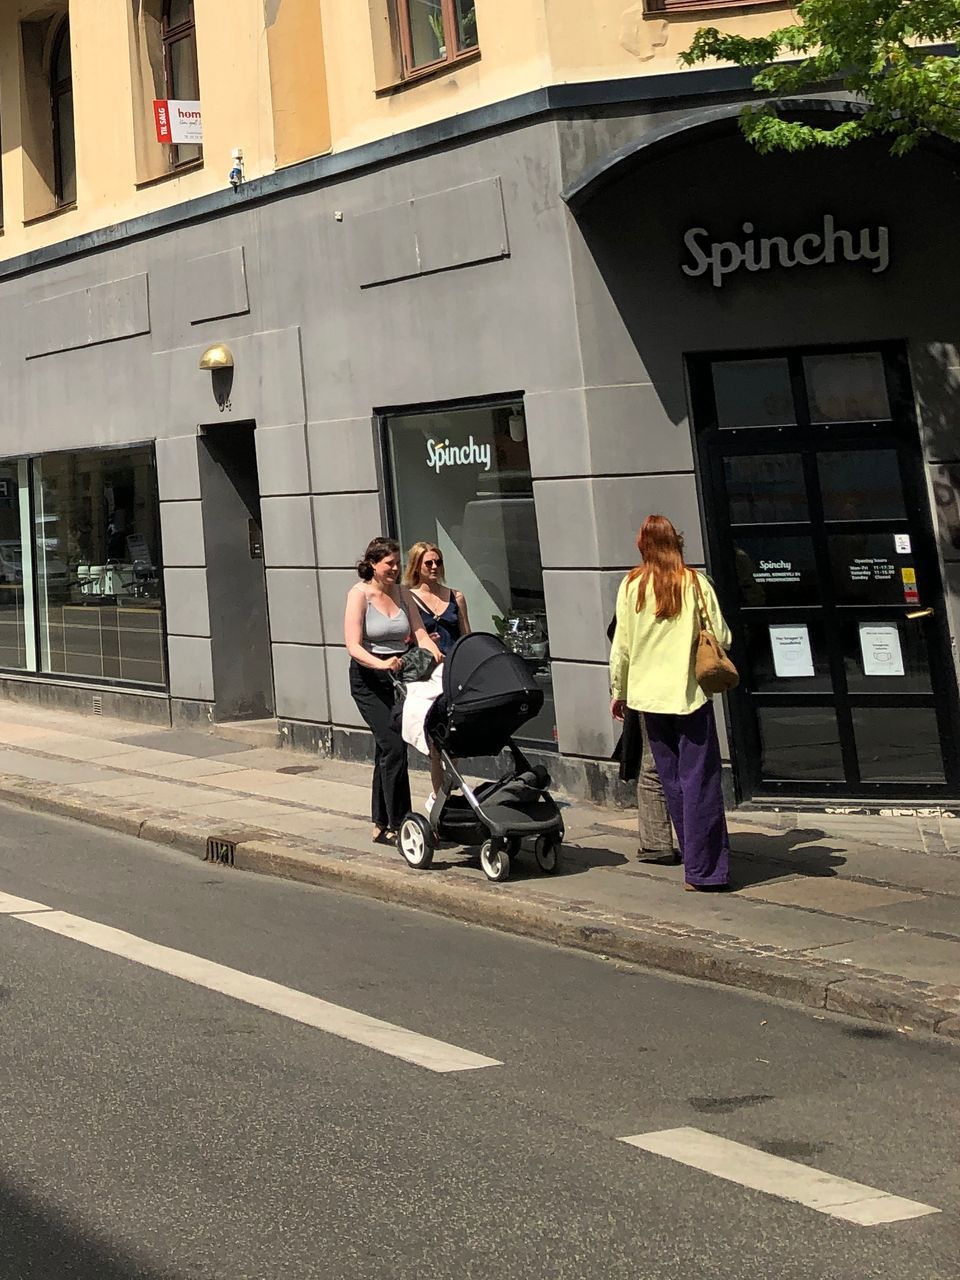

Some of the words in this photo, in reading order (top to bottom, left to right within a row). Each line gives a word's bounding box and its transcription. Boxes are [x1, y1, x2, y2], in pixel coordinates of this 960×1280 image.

[178, 108, 201, 118] hom
[681, 214, 889, 287] Spinchy
[426, 435, 491, 474] Spinchy
[759, 559, 792, 571] Spinchy
